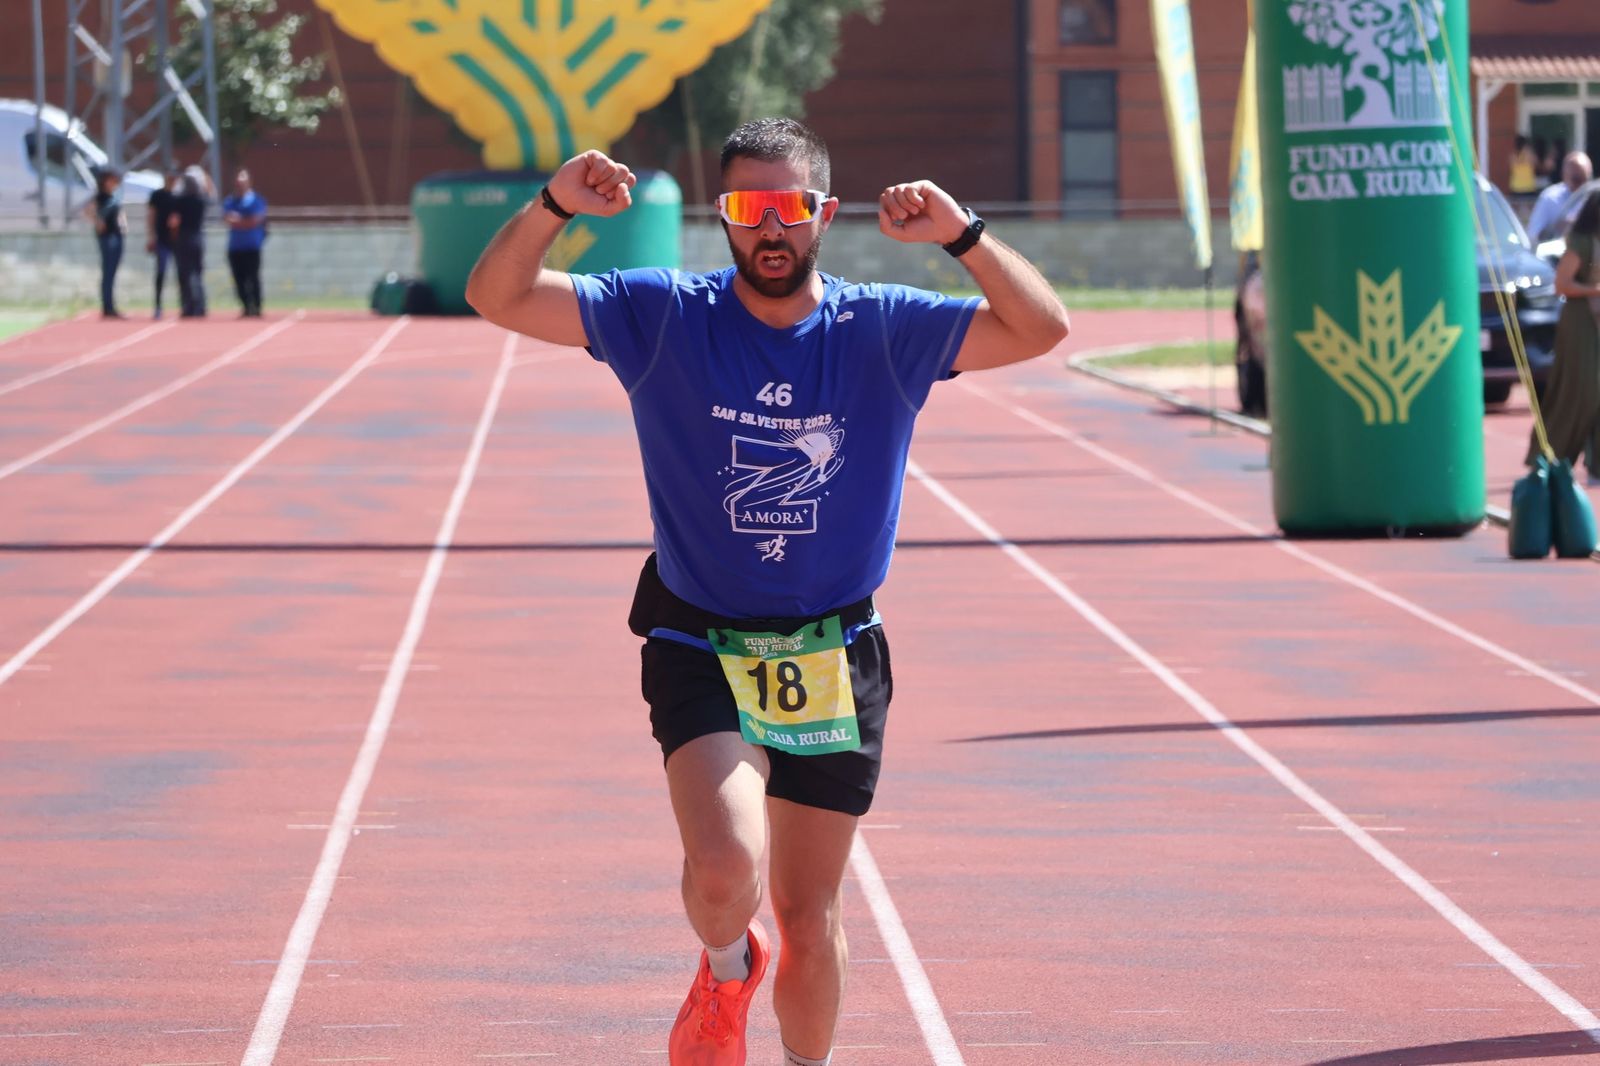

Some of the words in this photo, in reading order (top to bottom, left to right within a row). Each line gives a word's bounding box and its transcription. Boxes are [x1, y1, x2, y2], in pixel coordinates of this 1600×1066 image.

[1289, 140, 1454, 173] FUNDACION
[1289, 172, 1359, 202] CAJA
[1365, 168, 1456, 198] RURAL
[756, 382, 793, 407] 46
[711, 405, 737, 421] SAN
[739, 412, 801, 430] SILVESTRE
[803, 413, 832, 429] 2025
[741, 510, 804, 524] AMORA
[747, 661, 808, 713] 18
[767, 730, 797, 746] CAJA
[799, 728, 852, 746] RURAL
